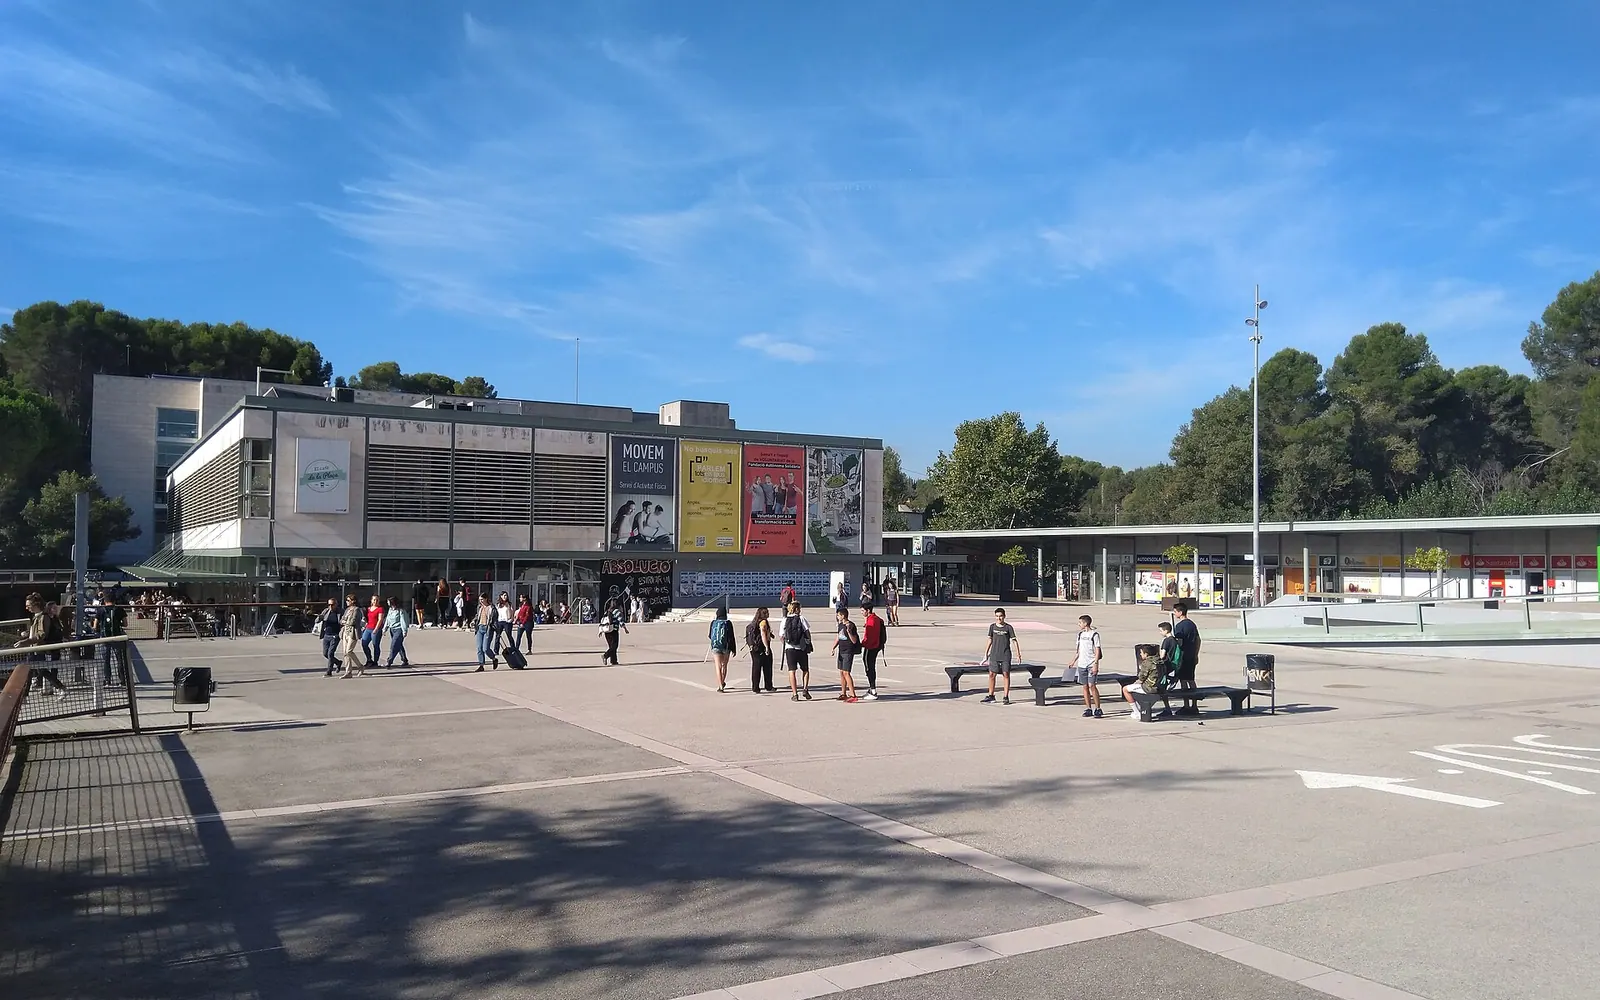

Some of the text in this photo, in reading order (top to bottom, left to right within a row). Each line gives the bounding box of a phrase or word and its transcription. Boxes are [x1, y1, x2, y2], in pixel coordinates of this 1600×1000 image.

[623, 443, 664, 460] MOVEM
[695, 446, 722, 455] busquis
[622, 461, 664, 475] EL CAMPUS
[632, 481, 654, 490] d'Activitat
[601, 559, 672, 575] ABSOLUCIÓ
[1486, 557, 1519, 567] Santander
